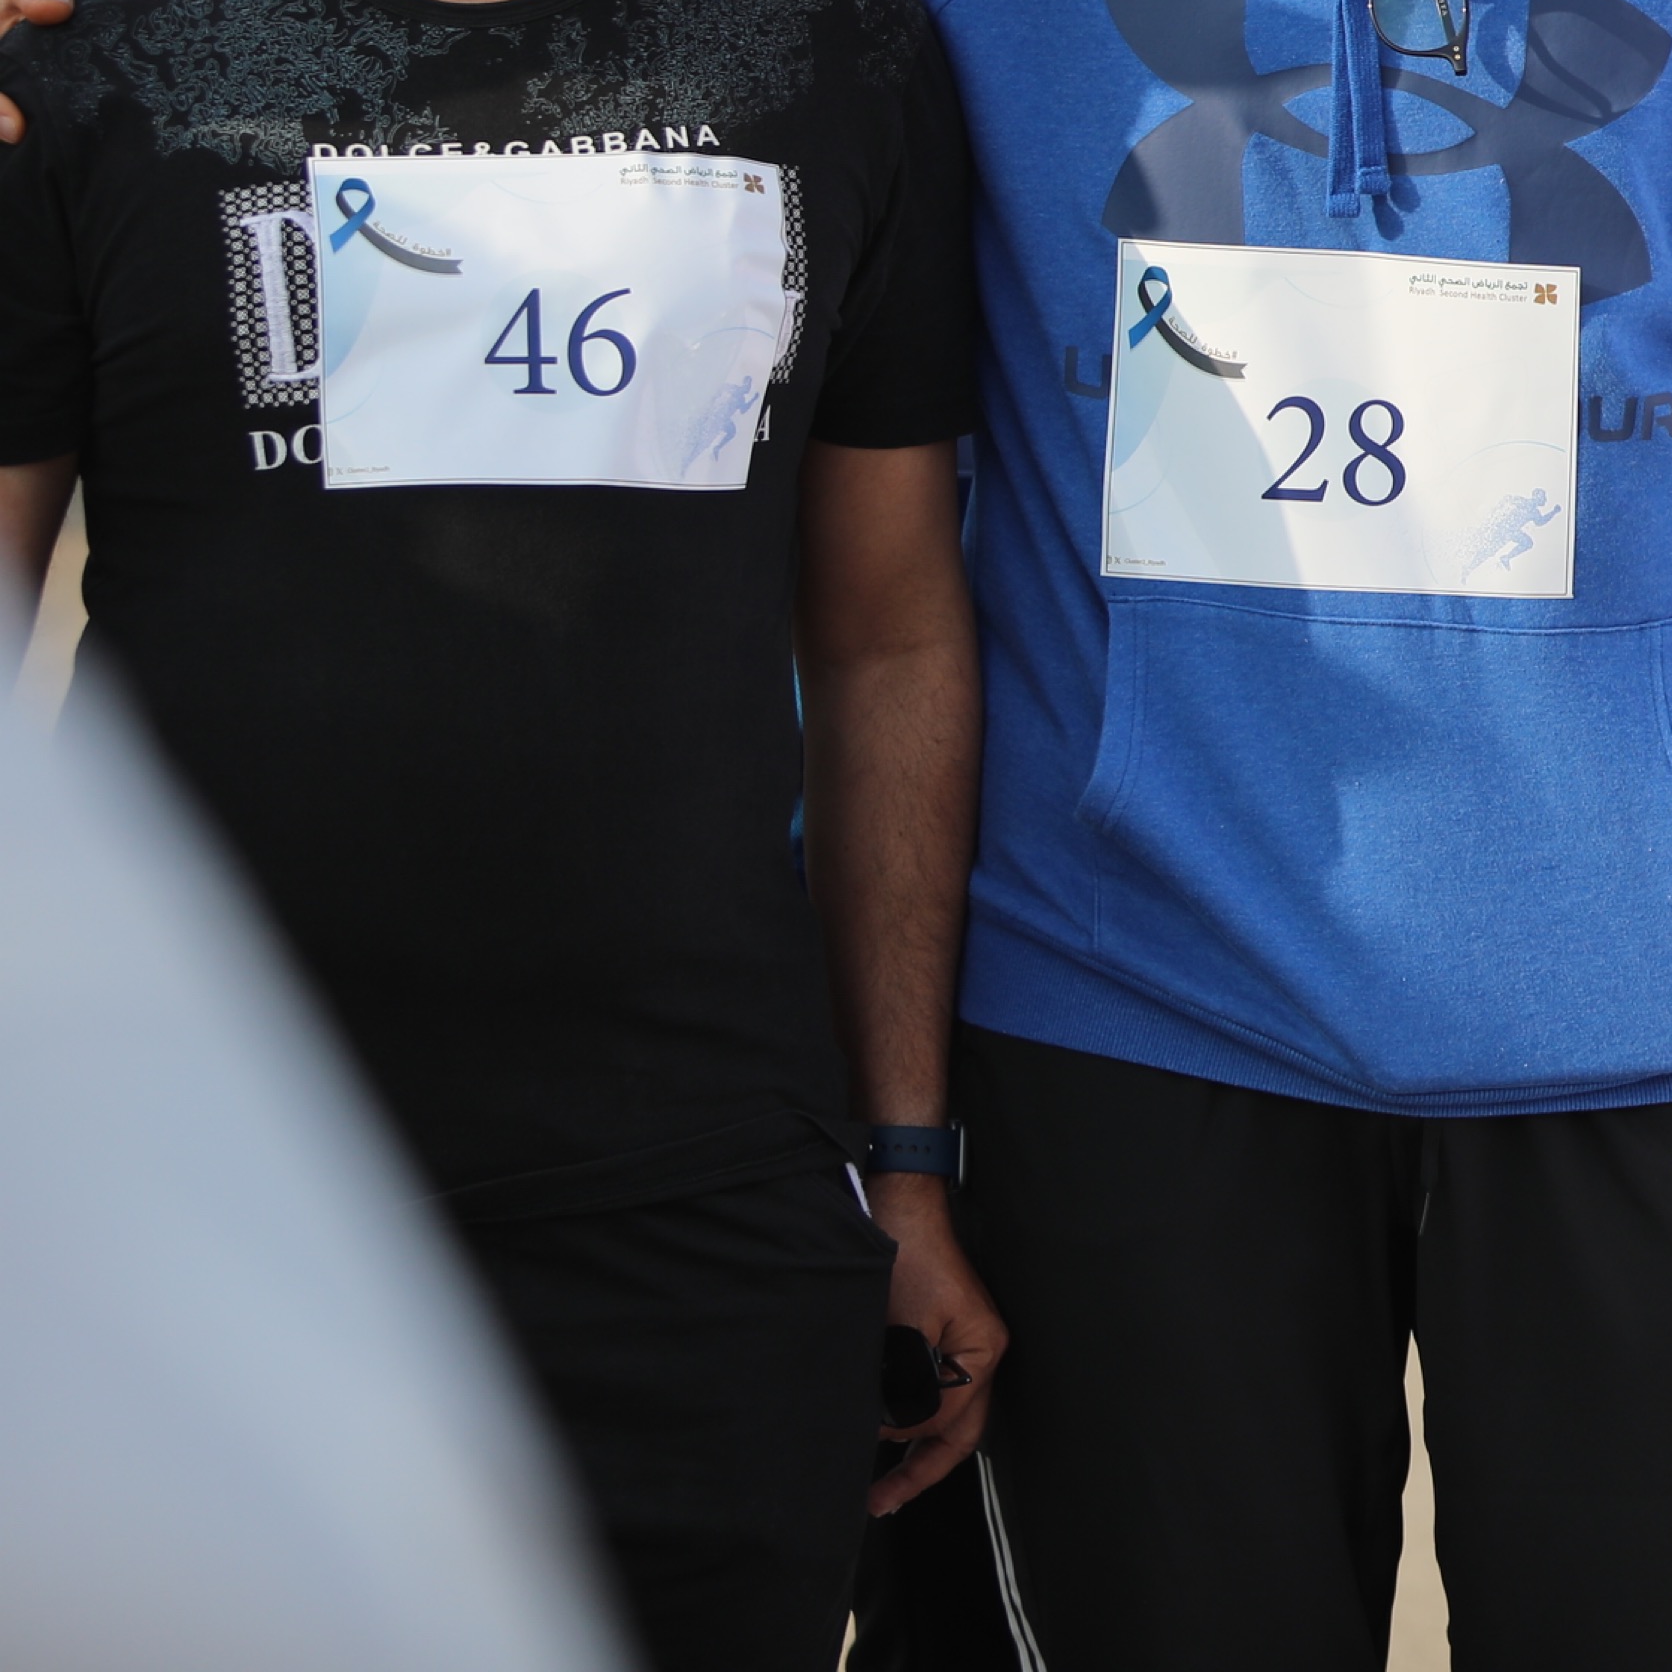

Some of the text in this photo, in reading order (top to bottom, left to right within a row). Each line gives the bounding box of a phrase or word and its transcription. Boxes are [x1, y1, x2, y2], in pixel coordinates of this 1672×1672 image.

[484, 288, 637, 397] 46
[1409, 286, 1528, 302] Riyadh Second Health Cluster
[1261, 395, 1407, 507] 28
